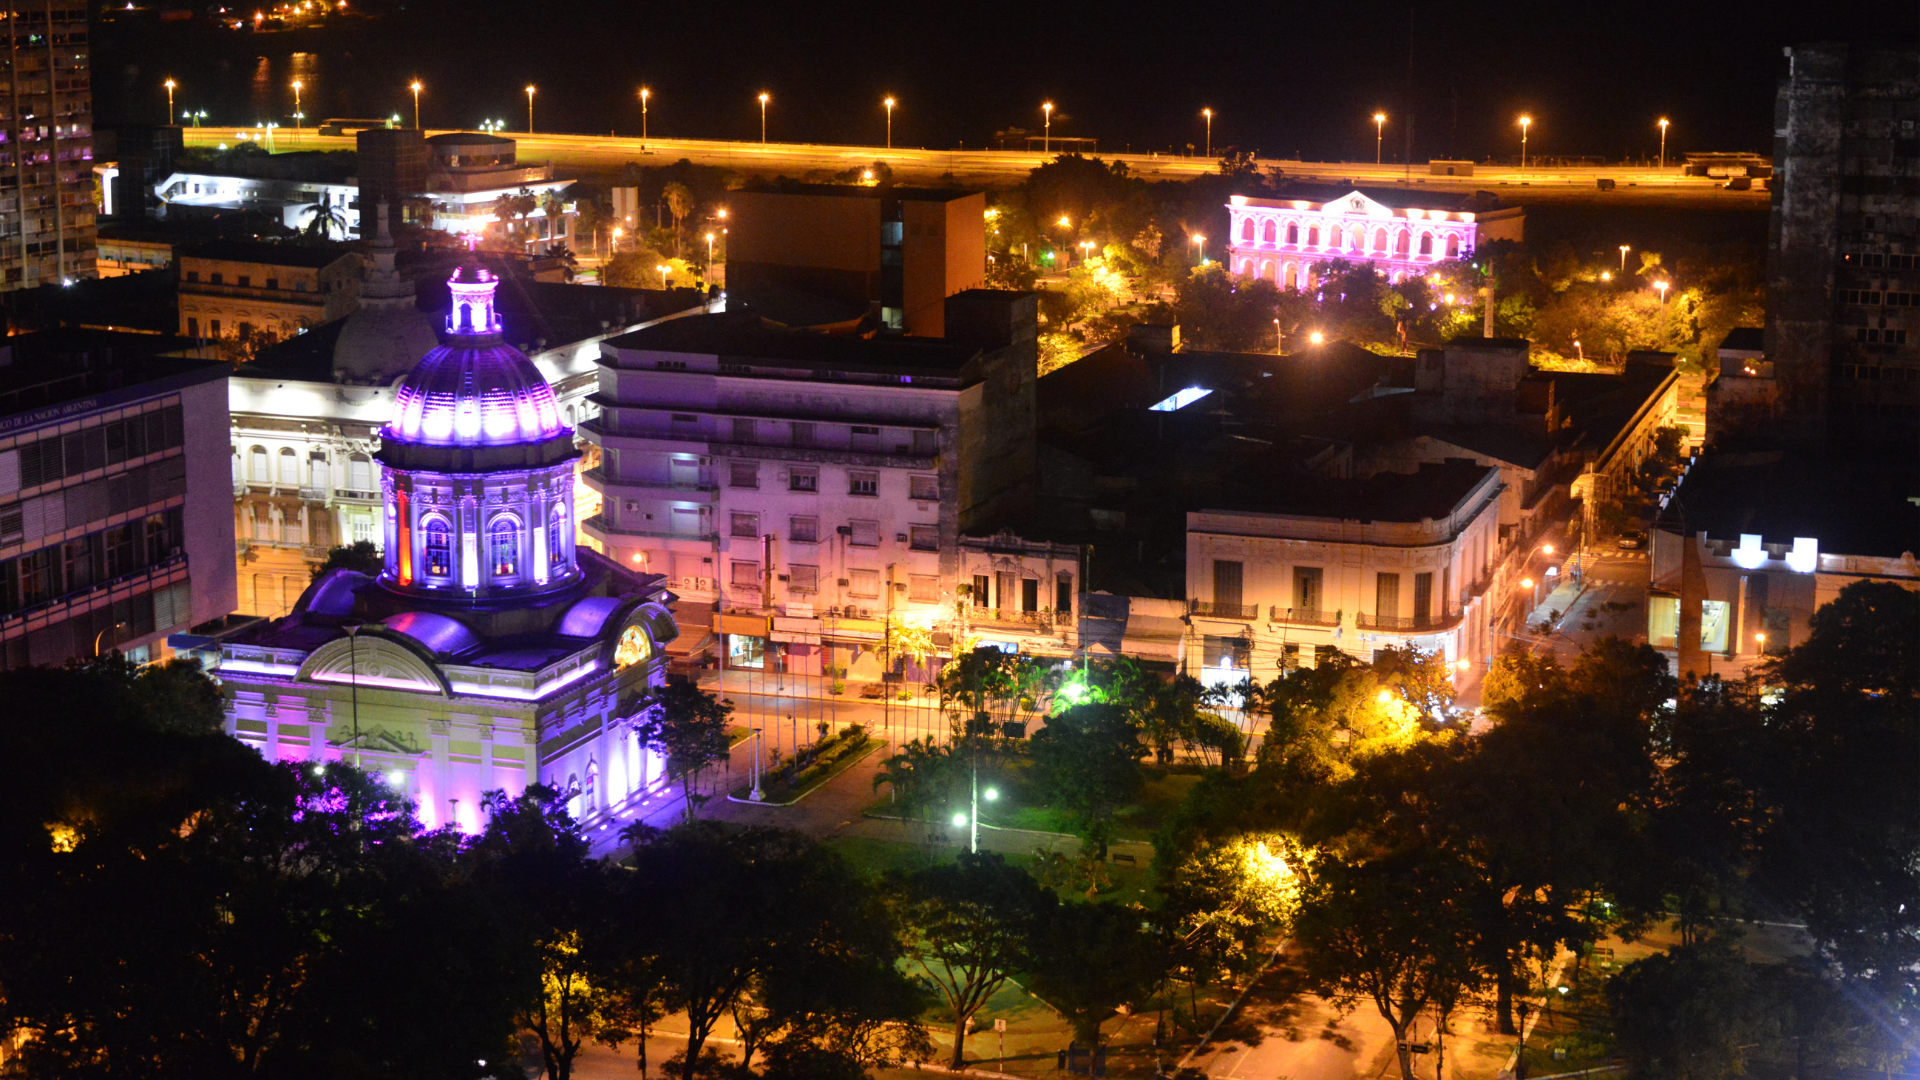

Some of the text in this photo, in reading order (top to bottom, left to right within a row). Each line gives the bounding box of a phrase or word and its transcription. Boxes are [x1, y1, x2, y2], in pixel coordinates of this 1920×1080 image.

[14, 417, 22, 426] DE
[24, 415, 33, 424] LA
[62, 399, 97, 414] ARGENTINA
